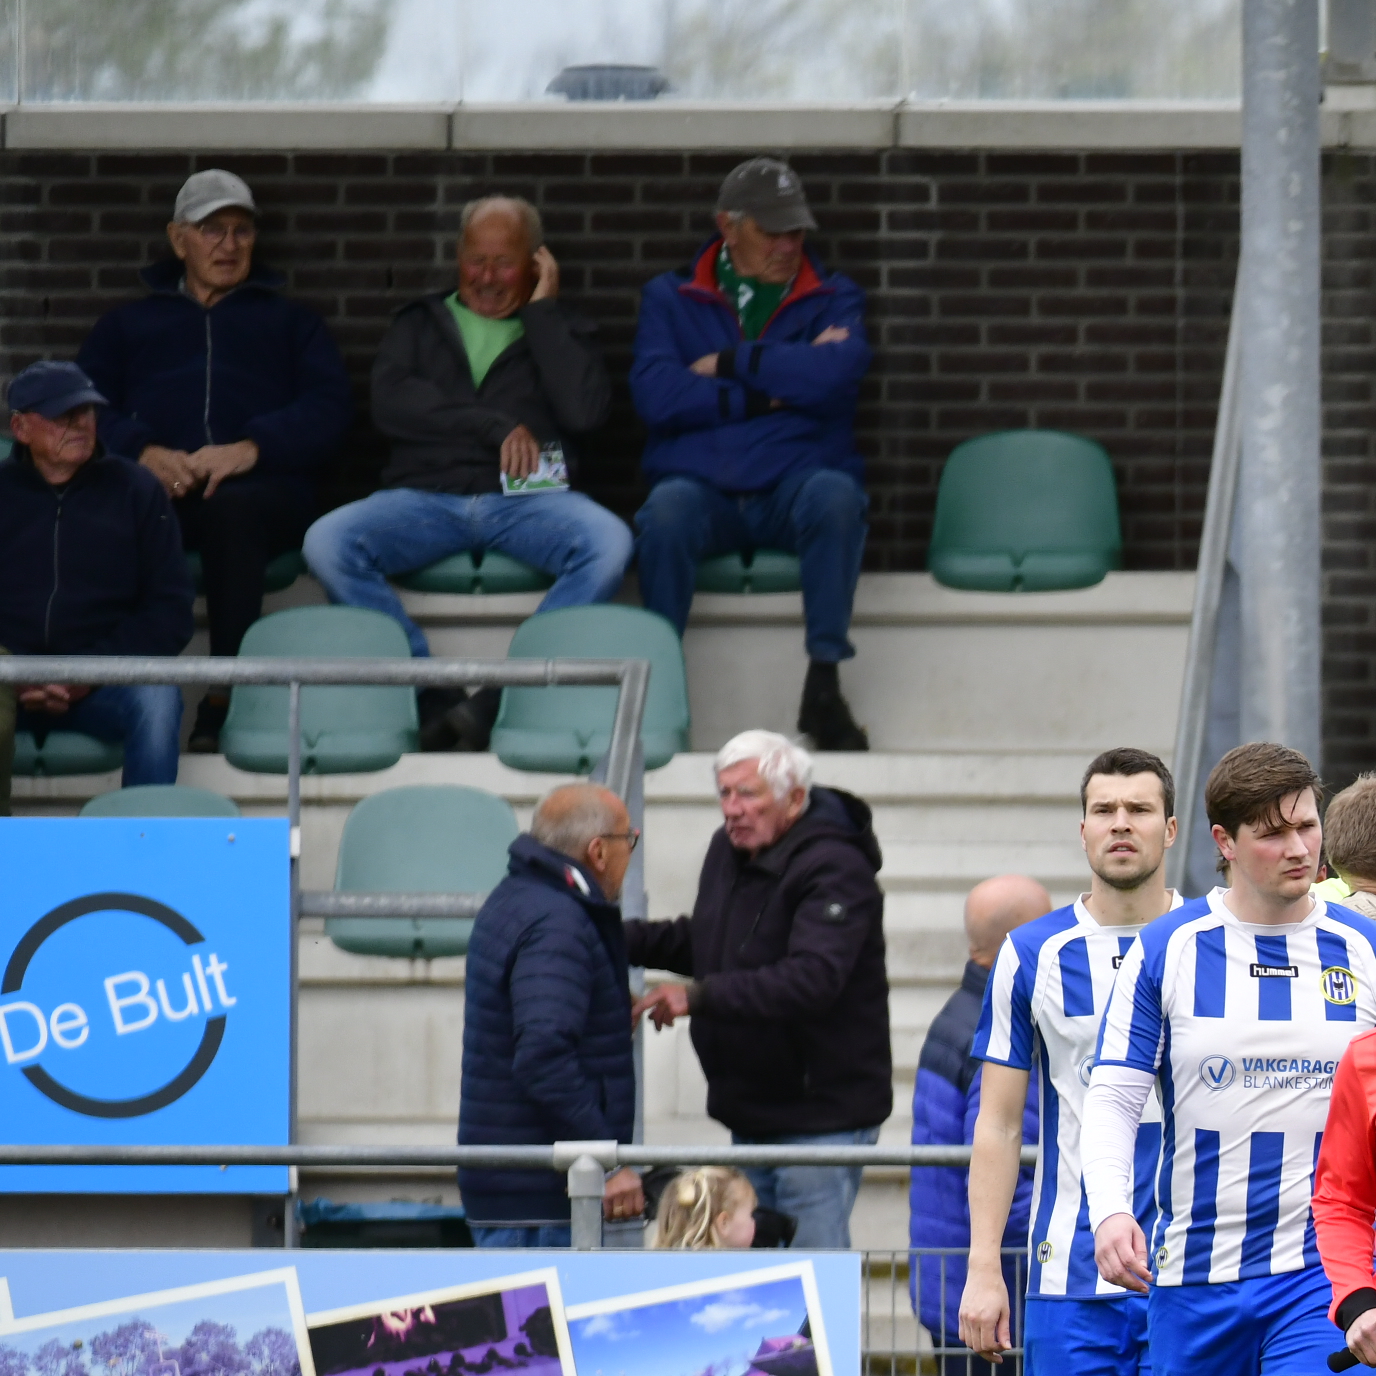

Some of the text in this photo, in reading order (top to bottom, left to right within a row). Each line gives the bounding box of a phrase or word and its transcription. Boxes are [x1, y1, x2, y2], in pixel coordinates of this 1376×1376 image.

[1253, 965, 1296, 977] hummel
[0, 953, 237, 1064] De Bult
